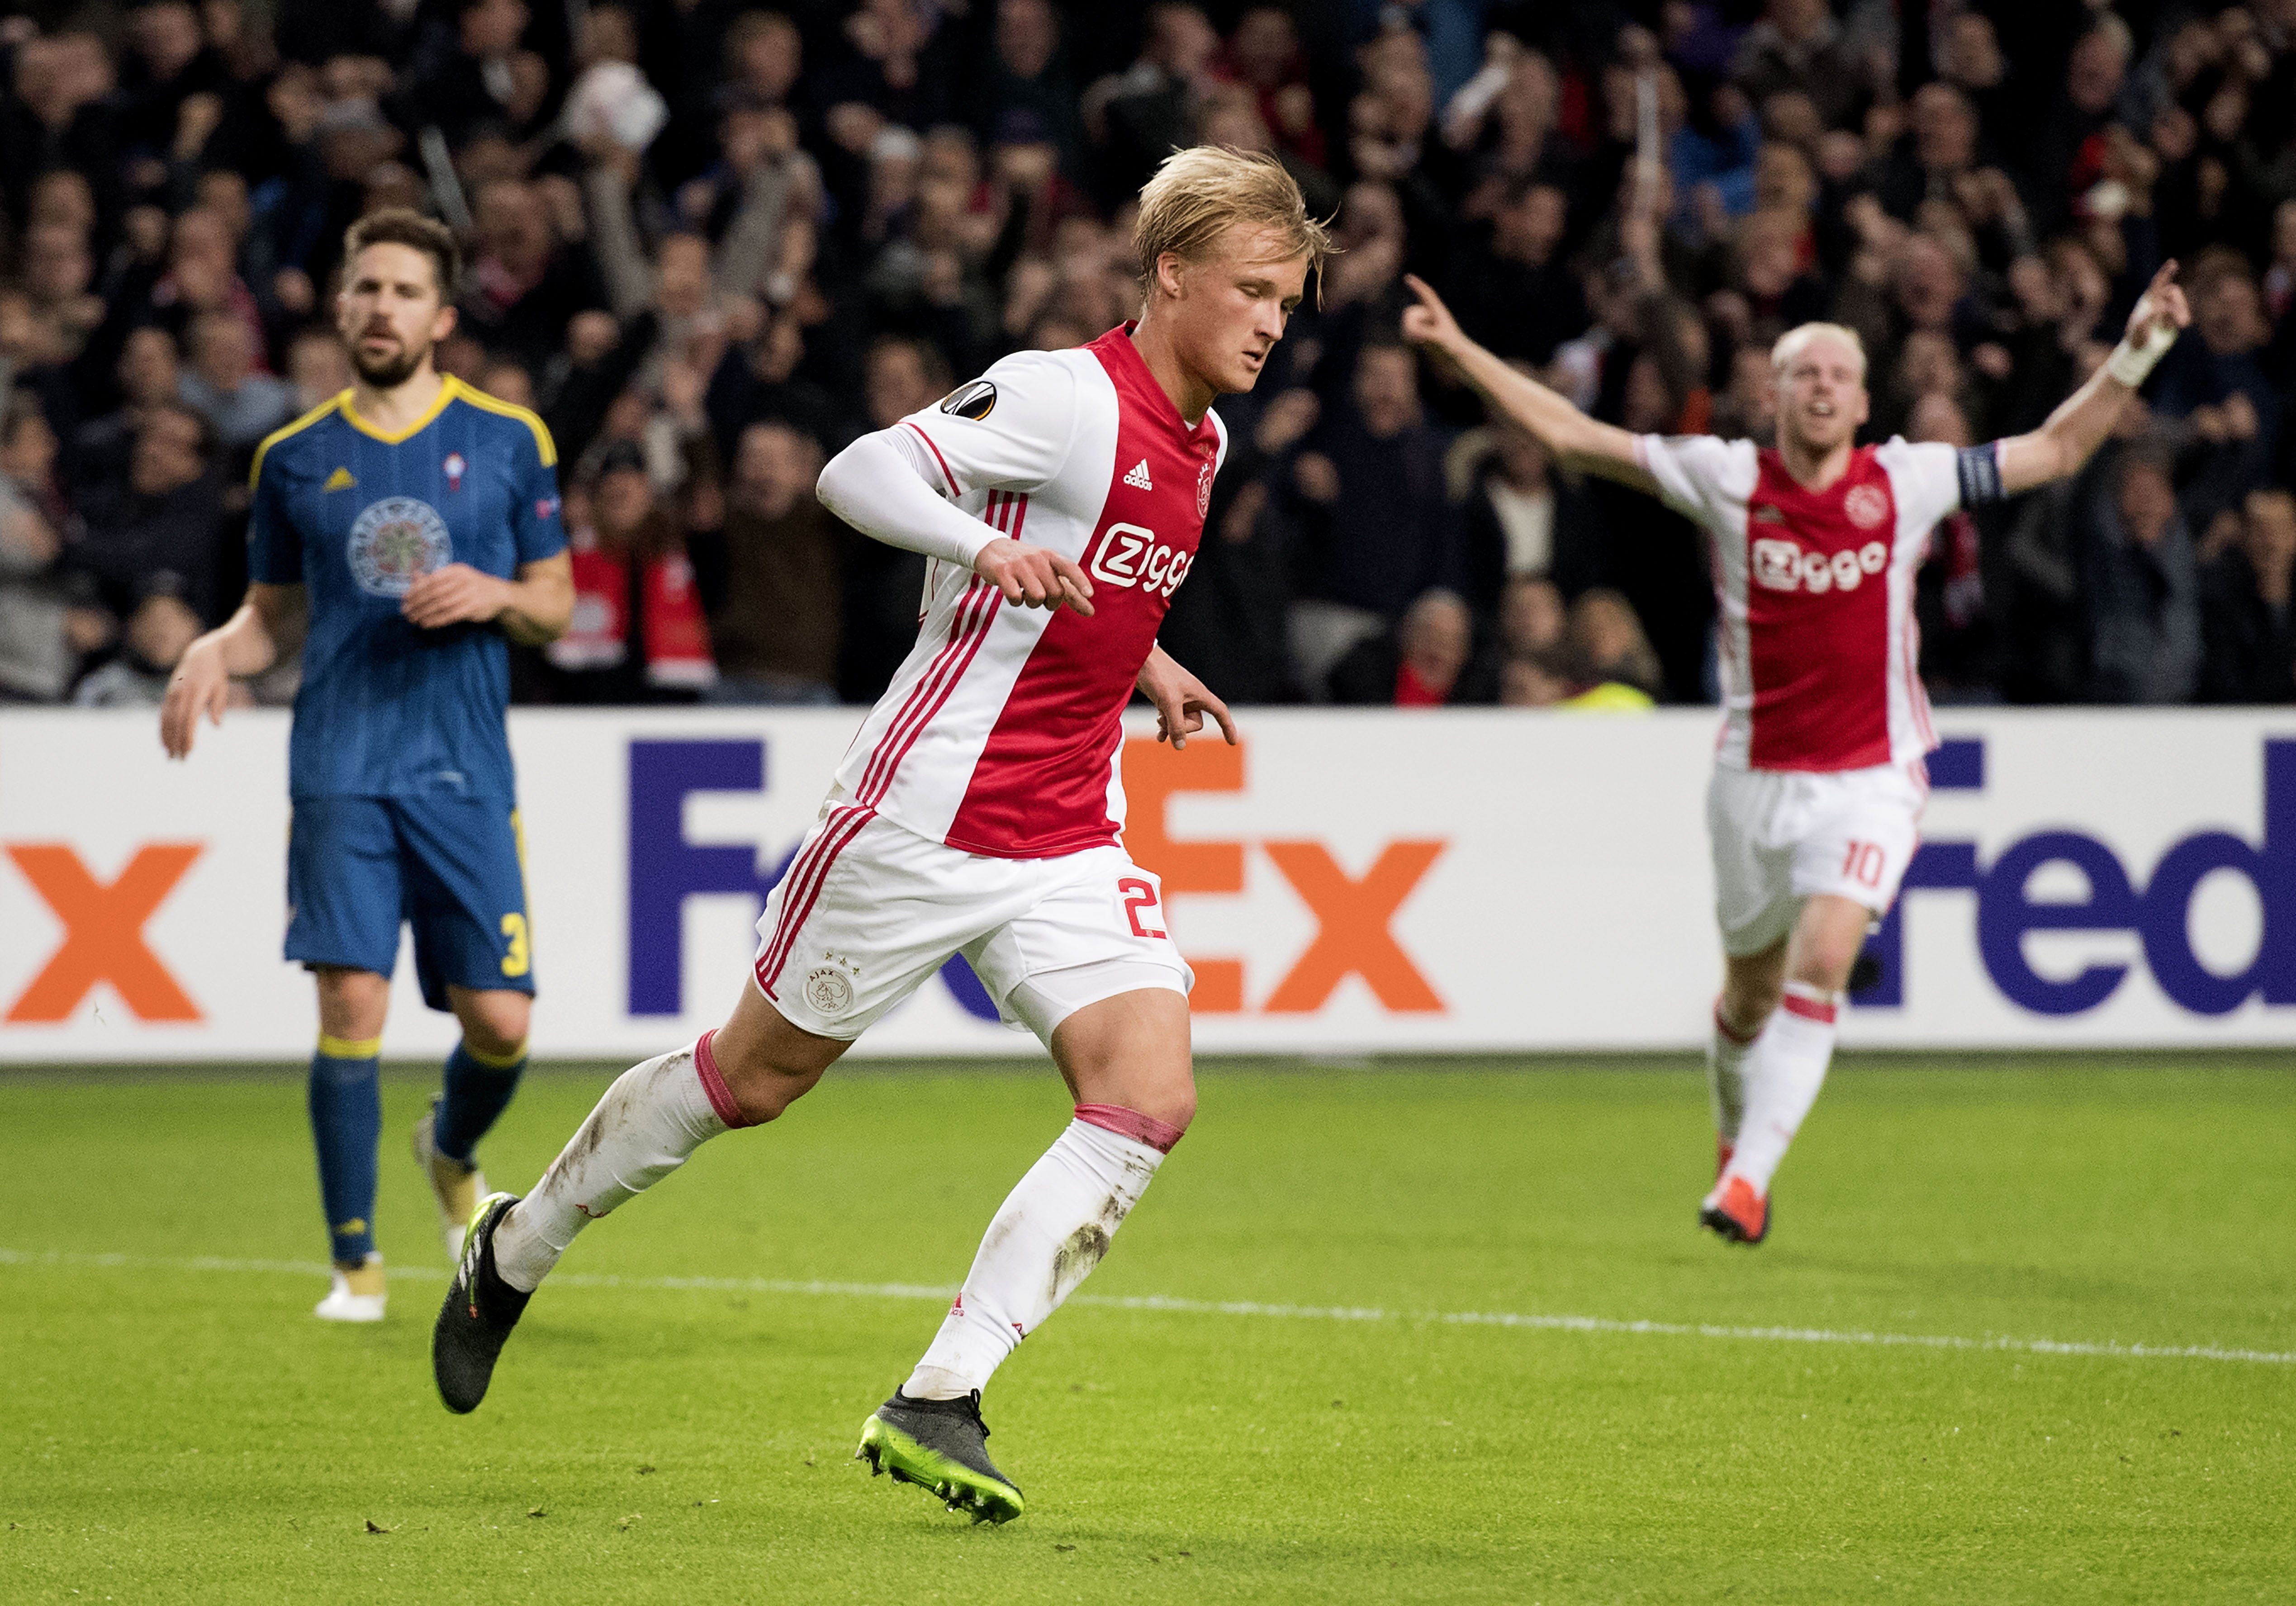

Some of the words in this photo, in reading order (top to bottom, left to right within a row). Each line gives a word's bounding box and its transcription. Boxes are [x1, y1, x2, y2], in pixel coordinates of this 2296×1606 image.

[1124, 474, 1153, 491] adidas
[627, 739, 1445, 1018] FEx
[1842, 840, 1885, 890] 10
[1118, 877, 1168, 940] 2
[500, 912, 529, 978] 3
[809, 970, 834, 982] AJAX
